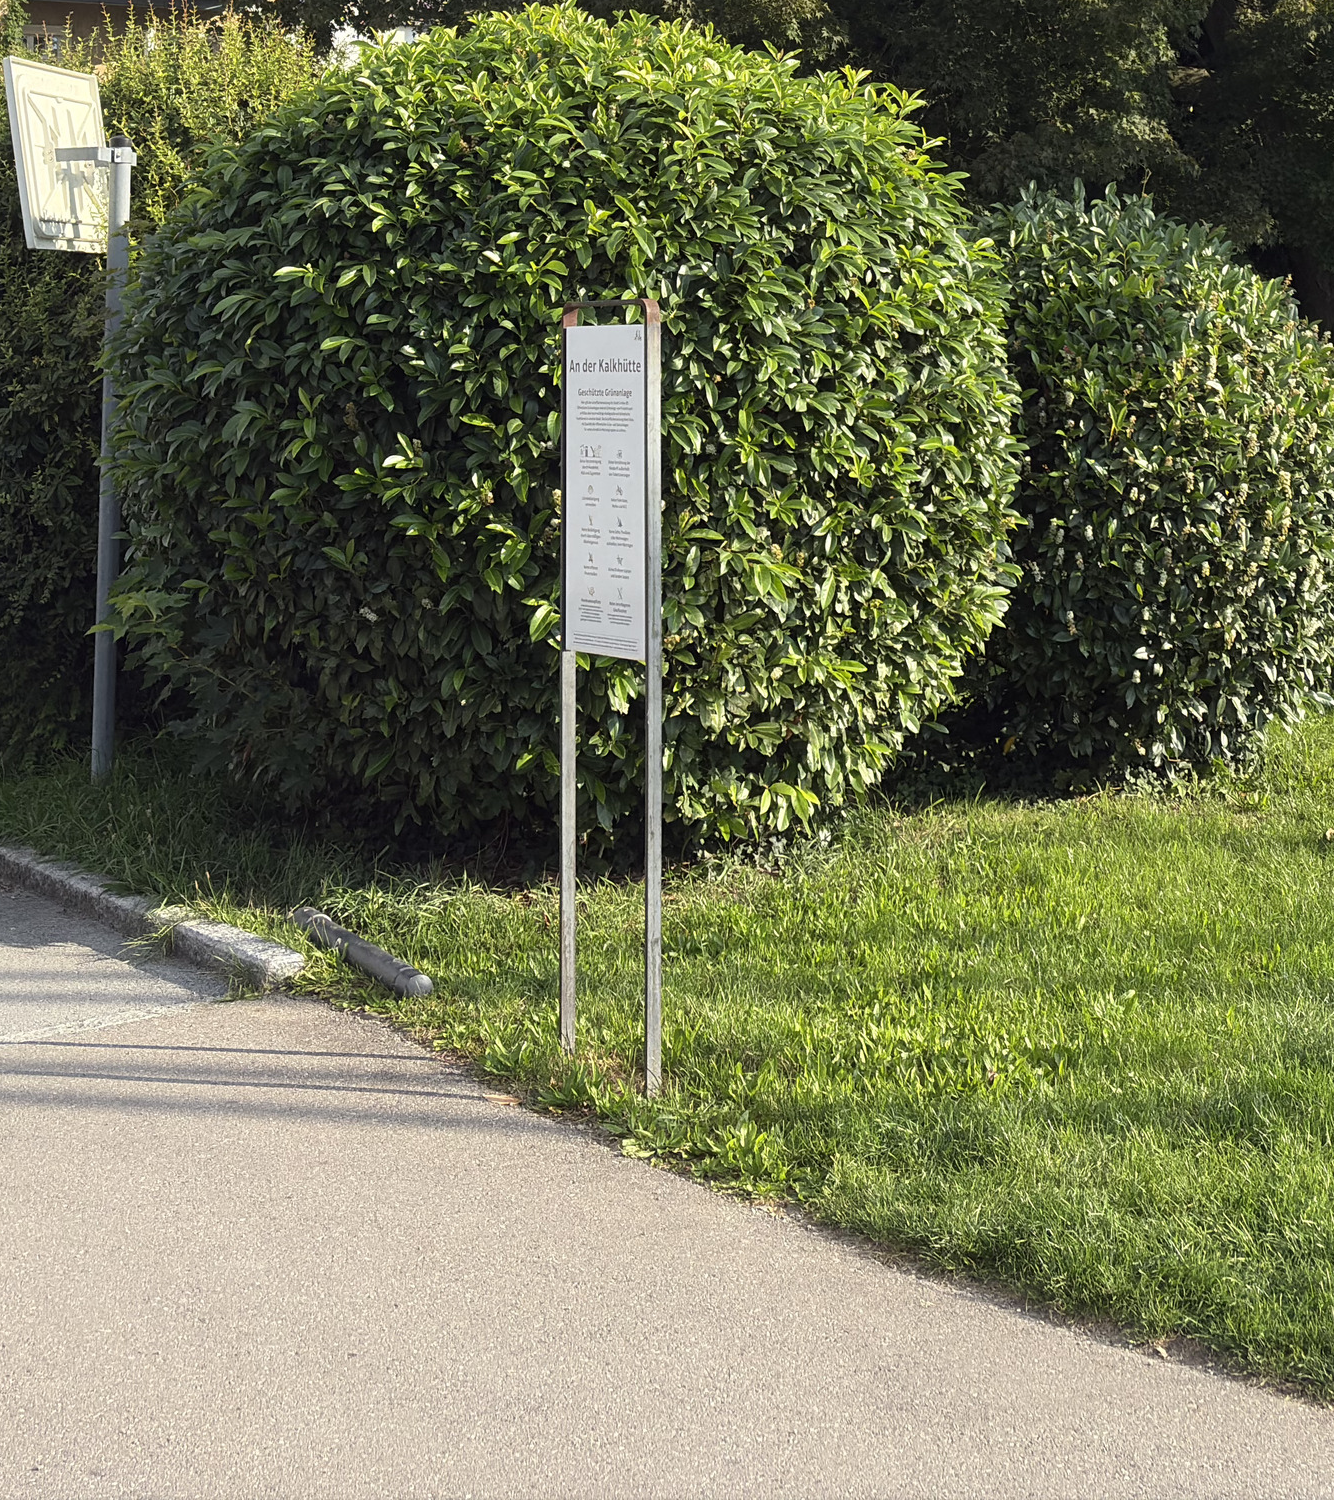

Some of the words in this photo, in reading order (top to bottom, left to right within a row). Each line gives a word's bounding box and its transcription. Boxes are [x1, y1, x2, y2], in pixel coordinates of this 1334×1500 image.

[569, 359, 581, 373] An
[582, 358, 597, 373] der
[598, 358, 642, 373] Kalkhütte
[578, 388, 604, 397] Geschützte
[604, 388, 633, 399] Grünanlage
